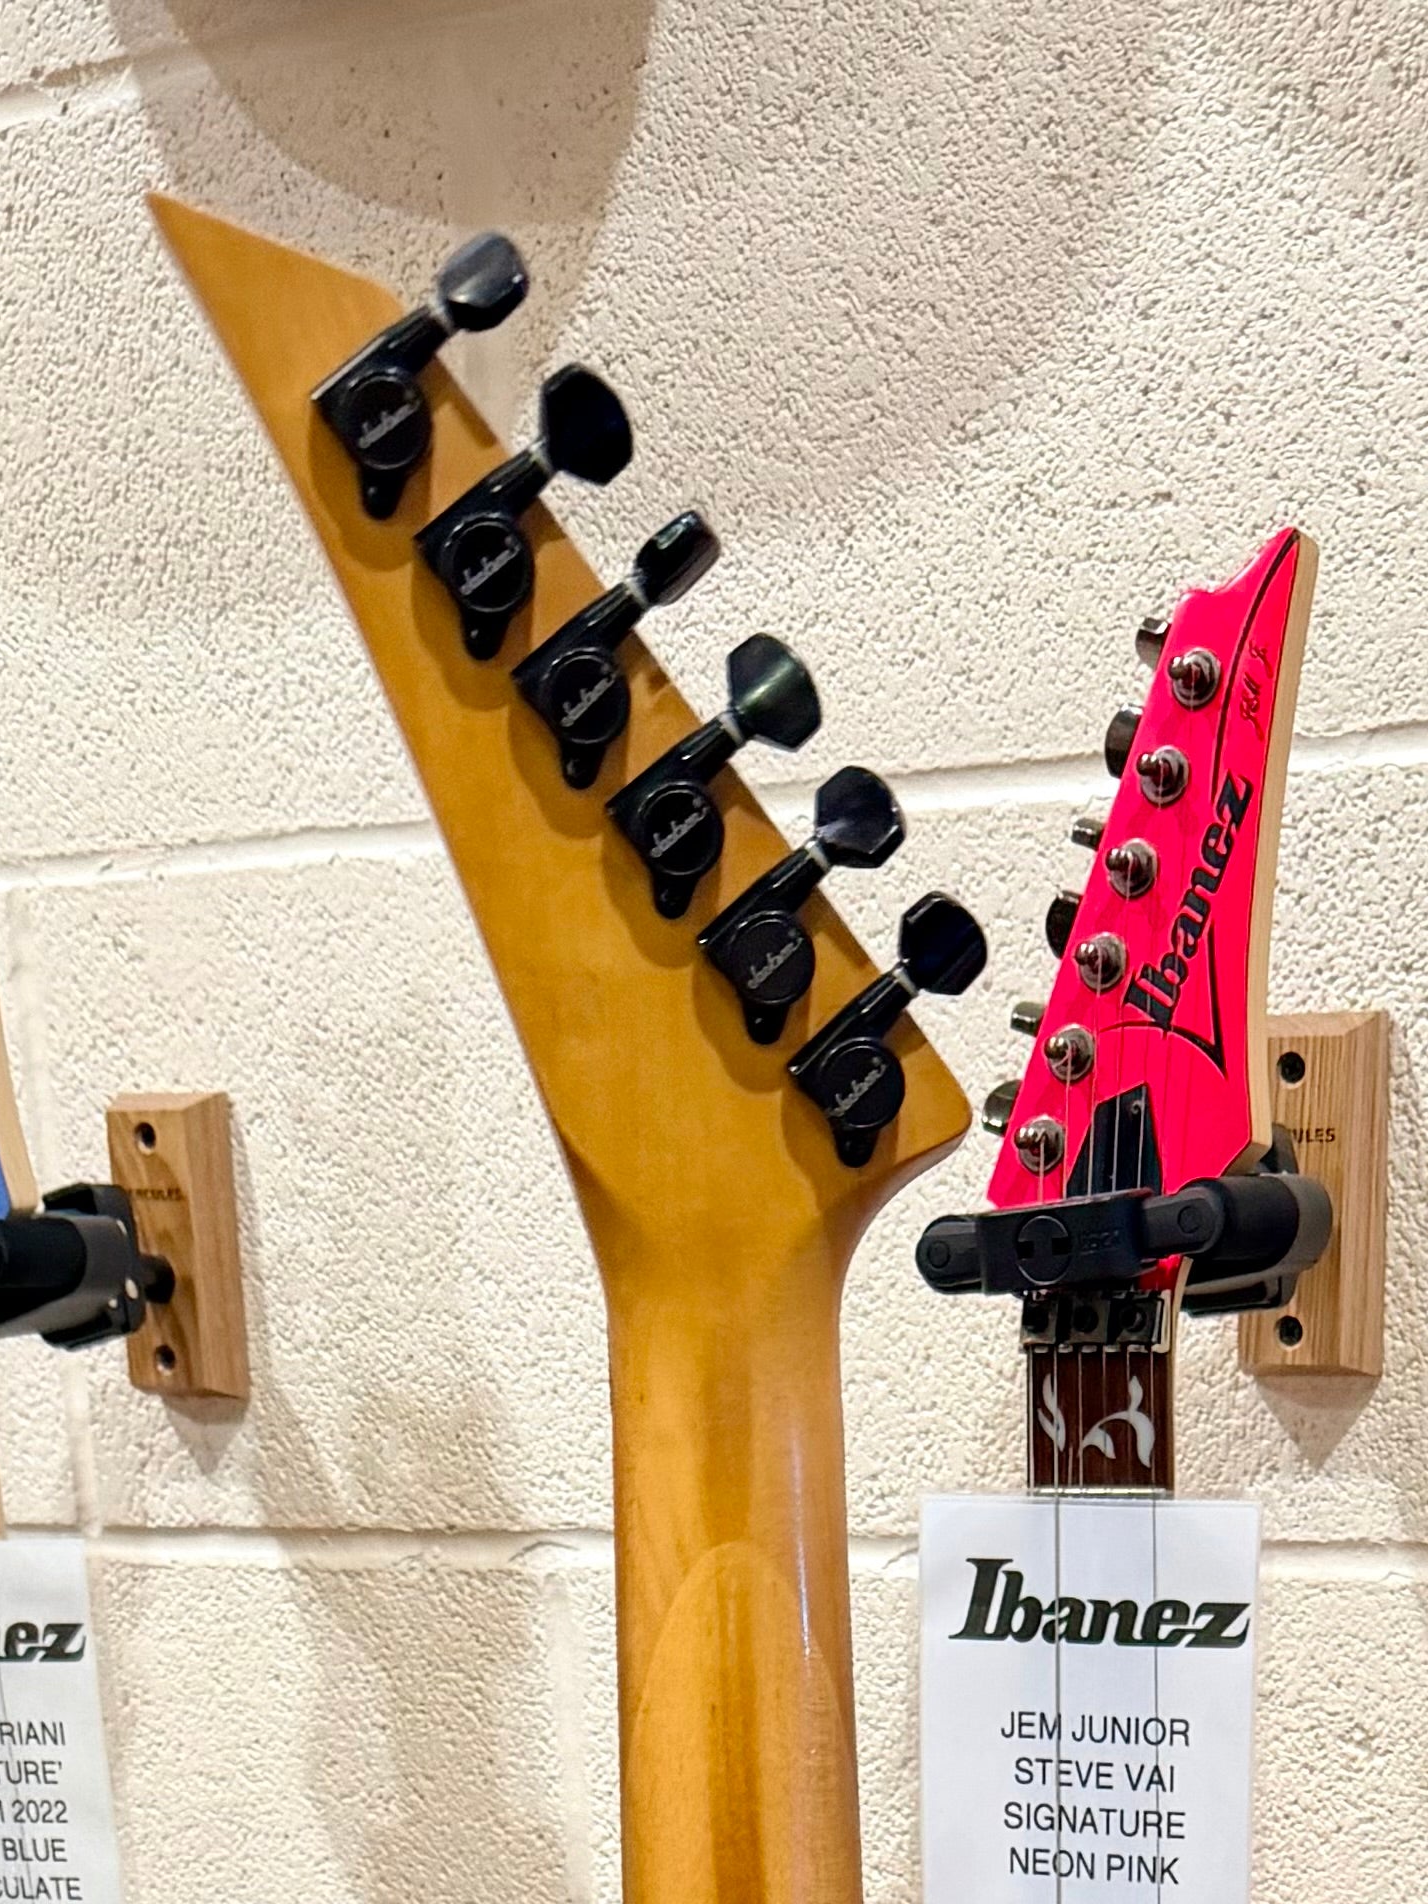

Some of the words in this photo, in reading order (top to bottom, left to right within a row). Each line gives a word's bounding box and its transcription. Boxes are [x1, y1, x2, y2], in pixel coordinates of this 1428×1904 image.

[1122, 770, 1254, 1031] Ibanez
[1293, 1128, 1335, 1143] ULES
[948, 1558, 1251, 1648] Ibanez
[1001, 1711, 1061, 1741] JEM
[1072, 1715, 1190, 1746] JUNIOR
[1014, 1757, 1113, 1791] STEVE
[1125, 1764, 1175, 1793] VAI
[12, 1799, 68, 1824] 2022
[1004, 1802, 1186, 1840] SIGNATURE
[4, 1838, 68, 1863] BLUE
[1009, 1847, 1096, 1880] NEON
[1107, 1854, 1180, 1885] PINK
